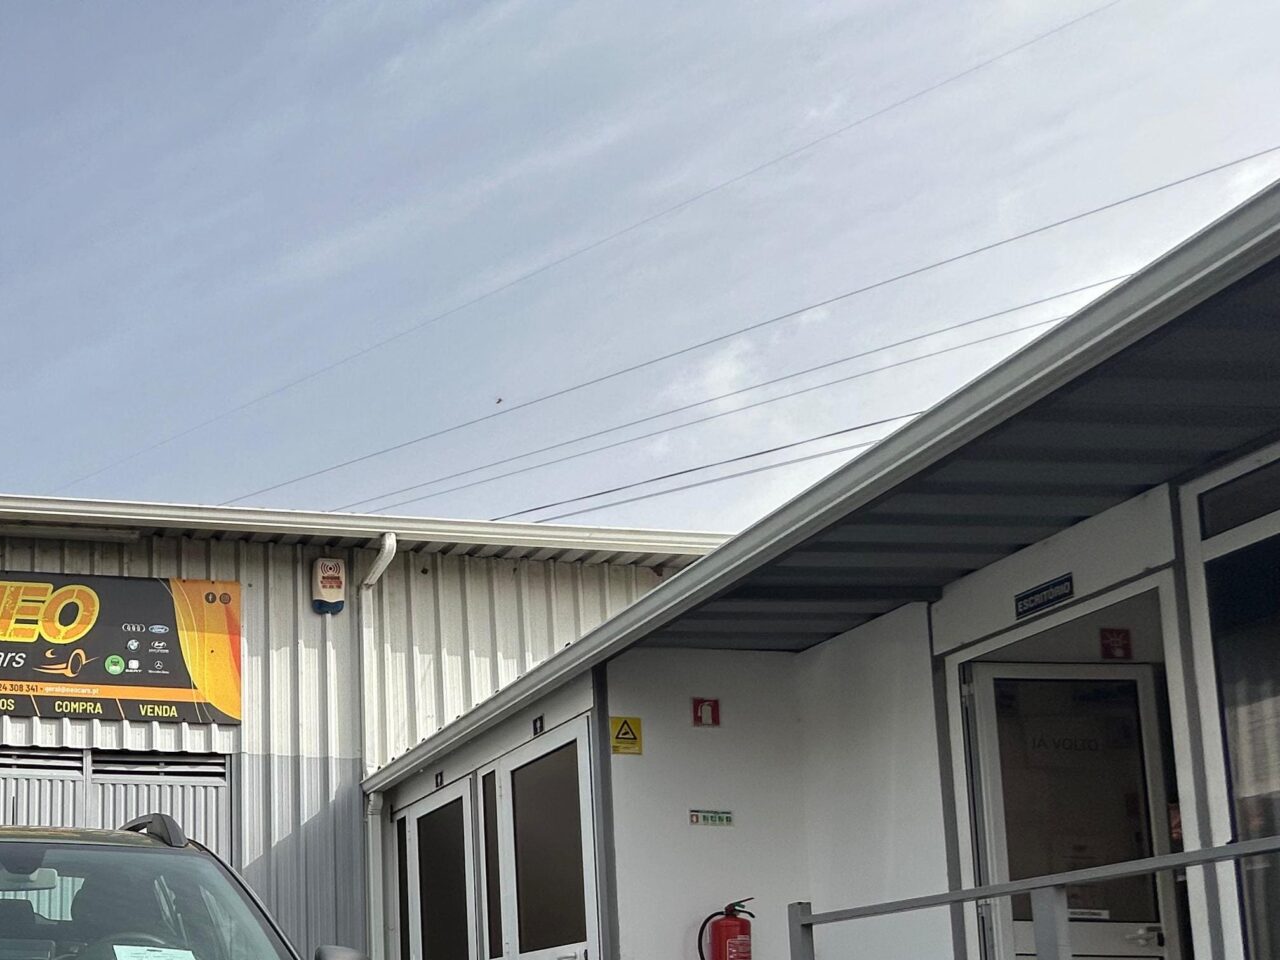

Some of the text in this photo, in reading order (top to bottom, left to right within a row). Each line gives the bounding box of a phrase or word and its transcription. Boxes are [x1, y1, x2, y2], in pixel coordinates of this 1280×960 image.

[9, 683, 24, 693] 308
[25, 684, 38, 693] 341
[55, 701, 103, 714] COMPRA
[139, 704, 178, 718] VENDA
